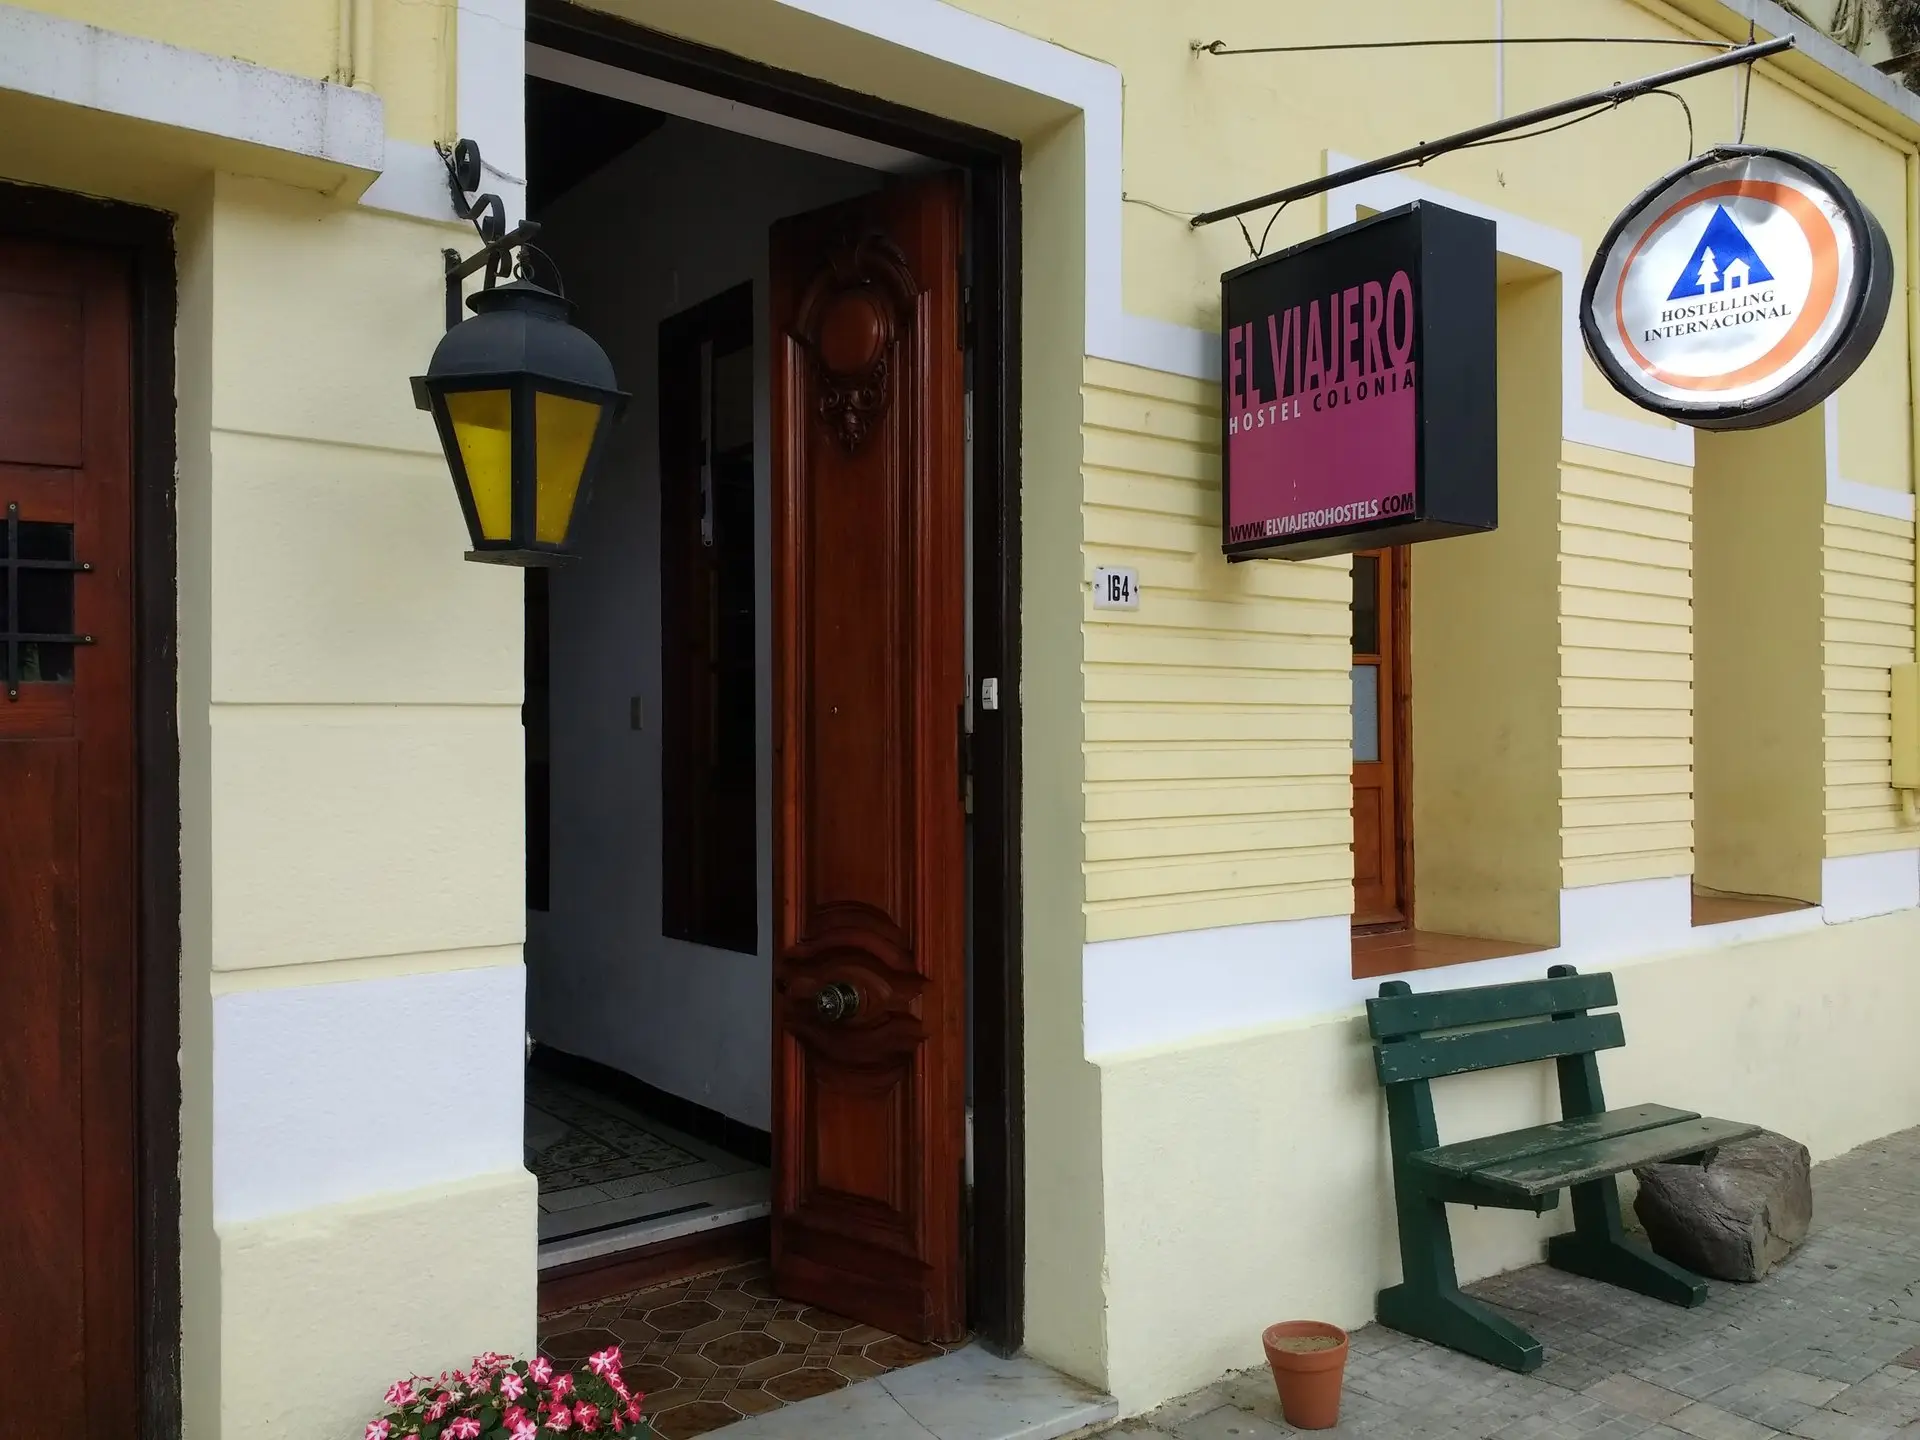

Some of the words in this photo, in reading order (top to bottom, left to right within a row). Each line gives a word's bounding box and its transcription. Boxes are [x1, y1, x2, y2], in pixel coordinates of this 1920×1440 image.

[1644, 303, 1792, 342] INTERNACIONAL
[1661, 290, 1775, 322] HOSTELLING
[1229, 322, 1260, 405] EL
[1268, 270, 1414, 400] VIAJERO
[1229, 401, 1301, 435] HOSTEL
[1313, 368, 1414, 412] COLONIA
[1231, 493, 1413, 541] WWW.ELVIAJEROHOSTELS.COM
[1108, 574, 1129, 602] 164
